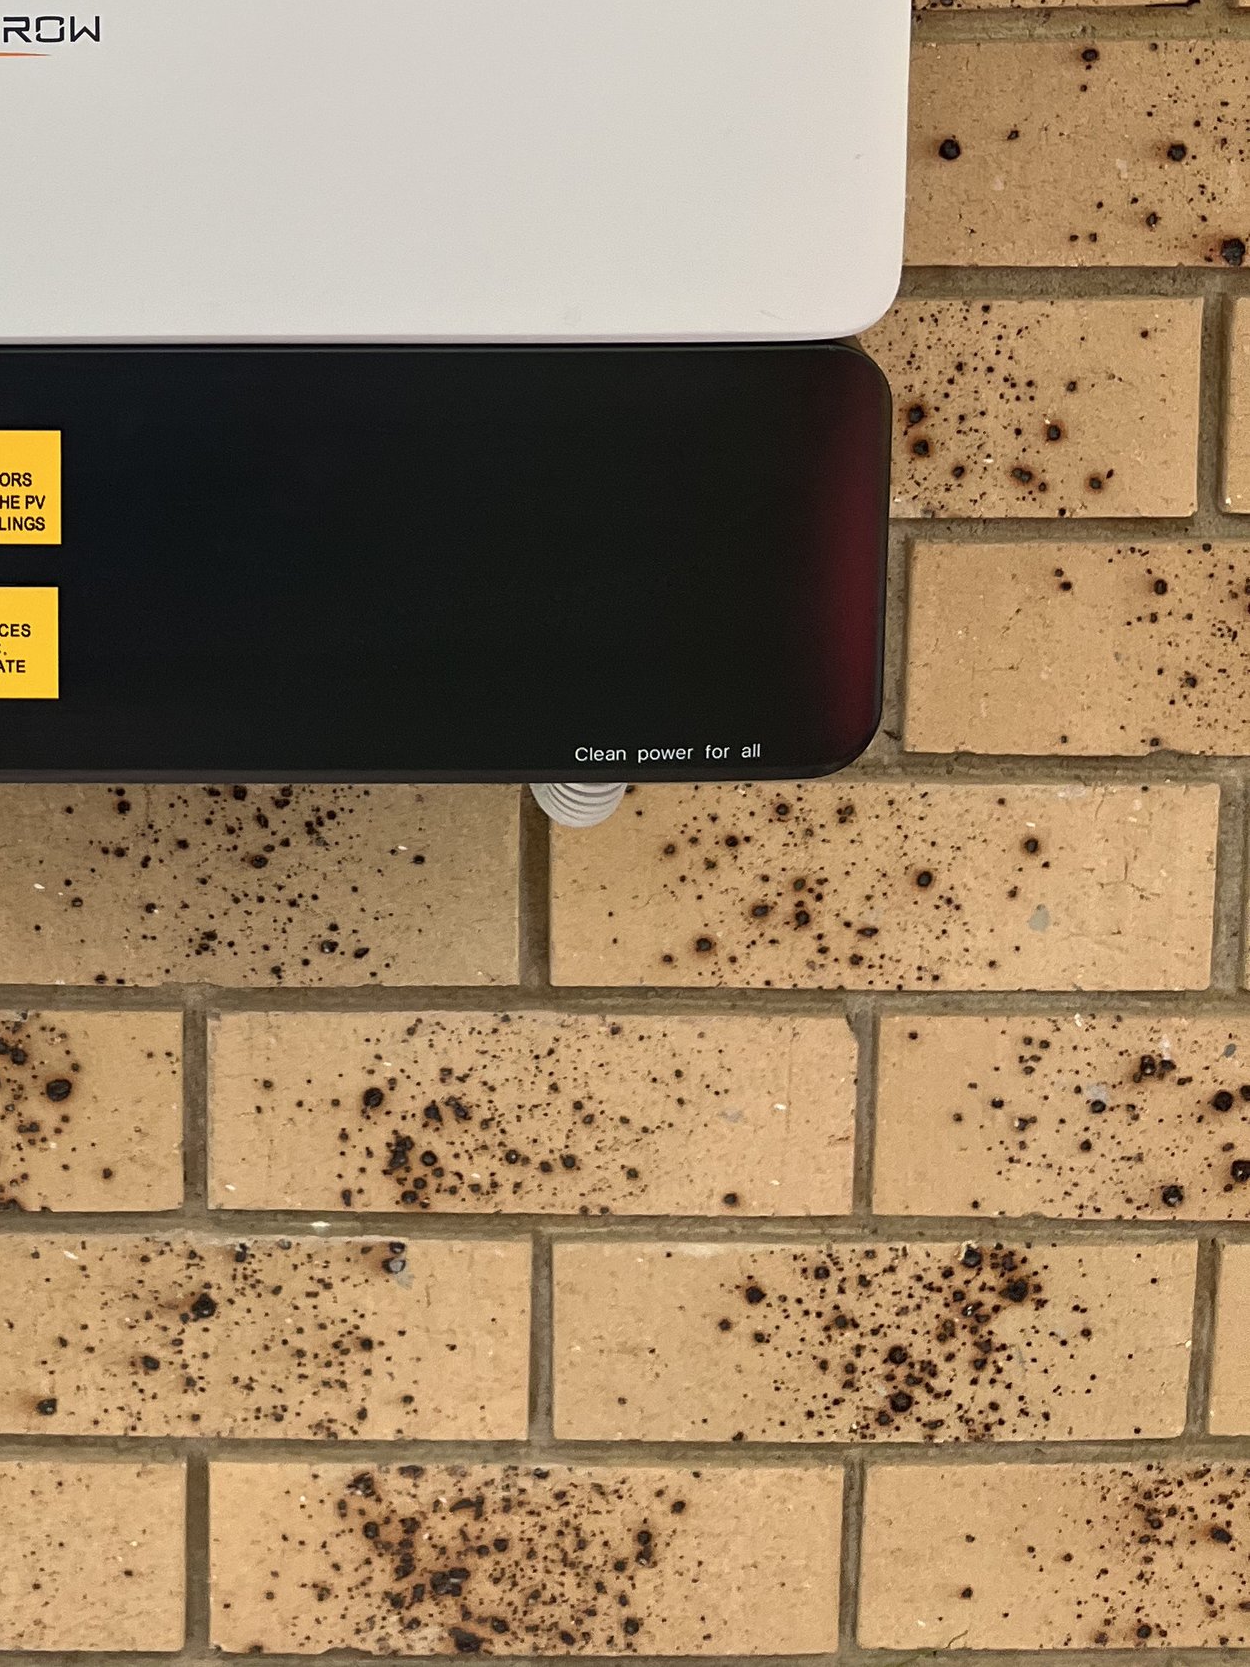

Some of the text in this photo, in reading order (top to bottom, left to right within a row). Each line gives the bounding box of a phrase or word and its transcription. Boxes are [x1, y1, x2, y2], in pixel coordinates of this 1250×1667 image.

[26, 495, 45, 509] PV
[575, 744, 760, 763] Clean power for all
